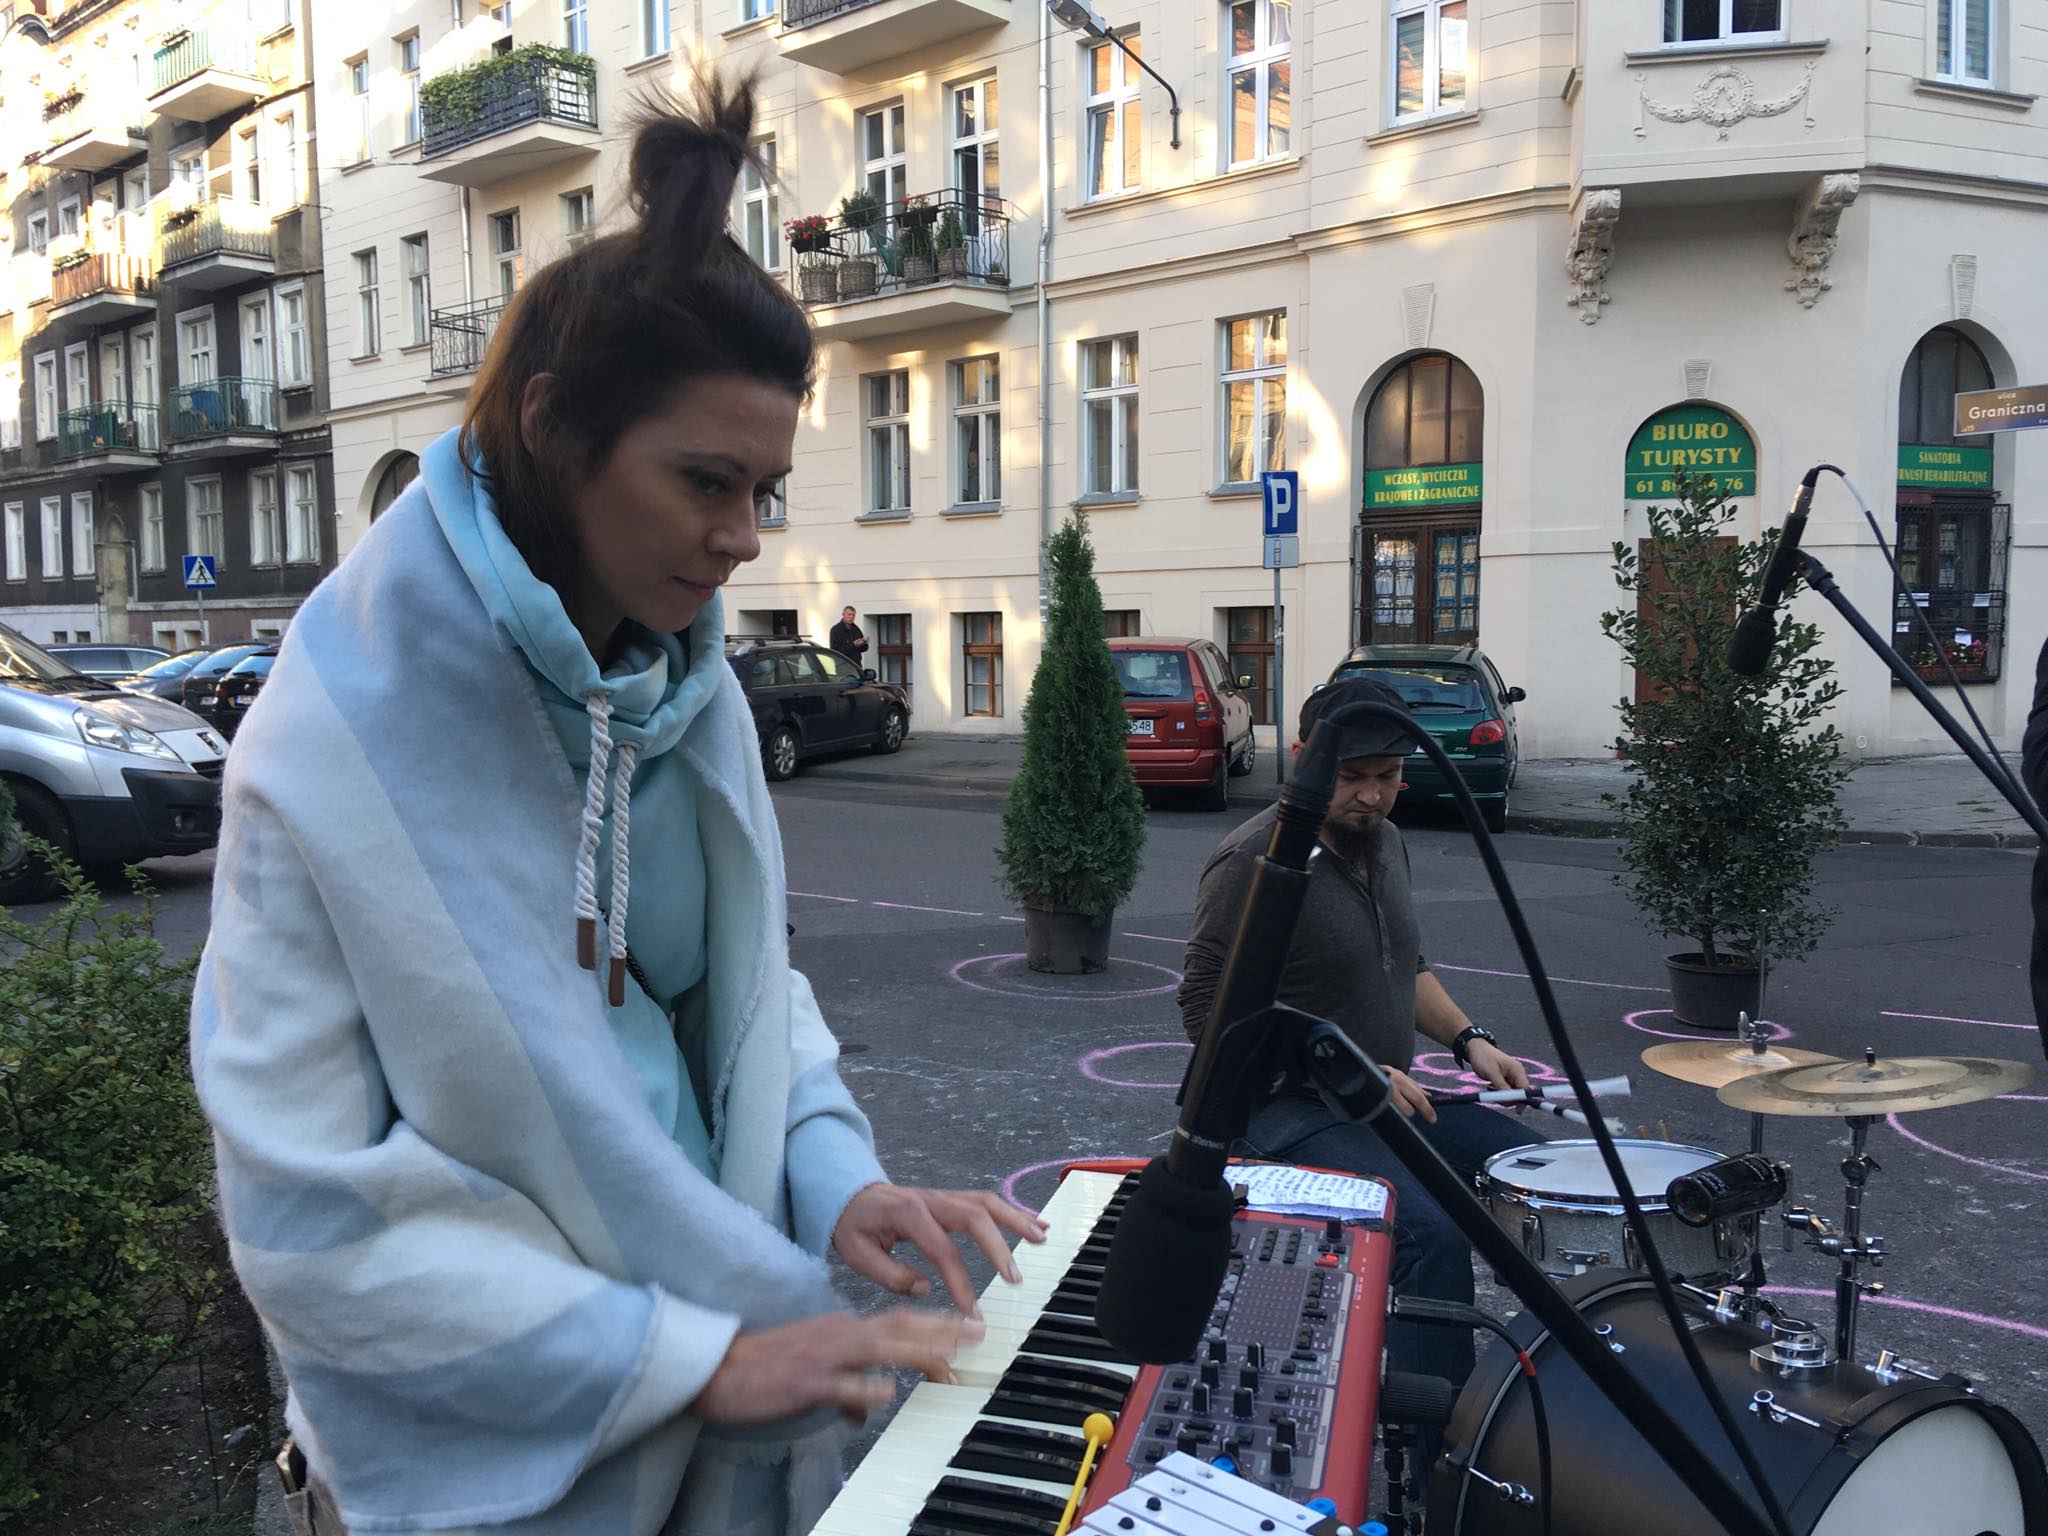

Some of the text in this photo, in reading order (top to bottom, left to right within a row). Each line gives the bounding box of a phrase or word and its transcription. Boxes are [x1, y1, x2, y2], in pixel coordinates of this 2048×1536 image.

[1968, 403, 2046, 420] Graniczna
[1652, 422, 1729, 441] BIURO
[1640, 447, 1742, 467] TURYSTY
[1384, 469, 1468, 486] WCZASY, WYCIECZKI
[1636, 480, 1654, 493] 61
[1724, 478, 1744, 490] 76
[1375, 485, 1479, 503] KRAJOWE I ZAGRANICZNE
[1270, 478, 1292, 528] P
[1130, 720, 1152, 732] 548
